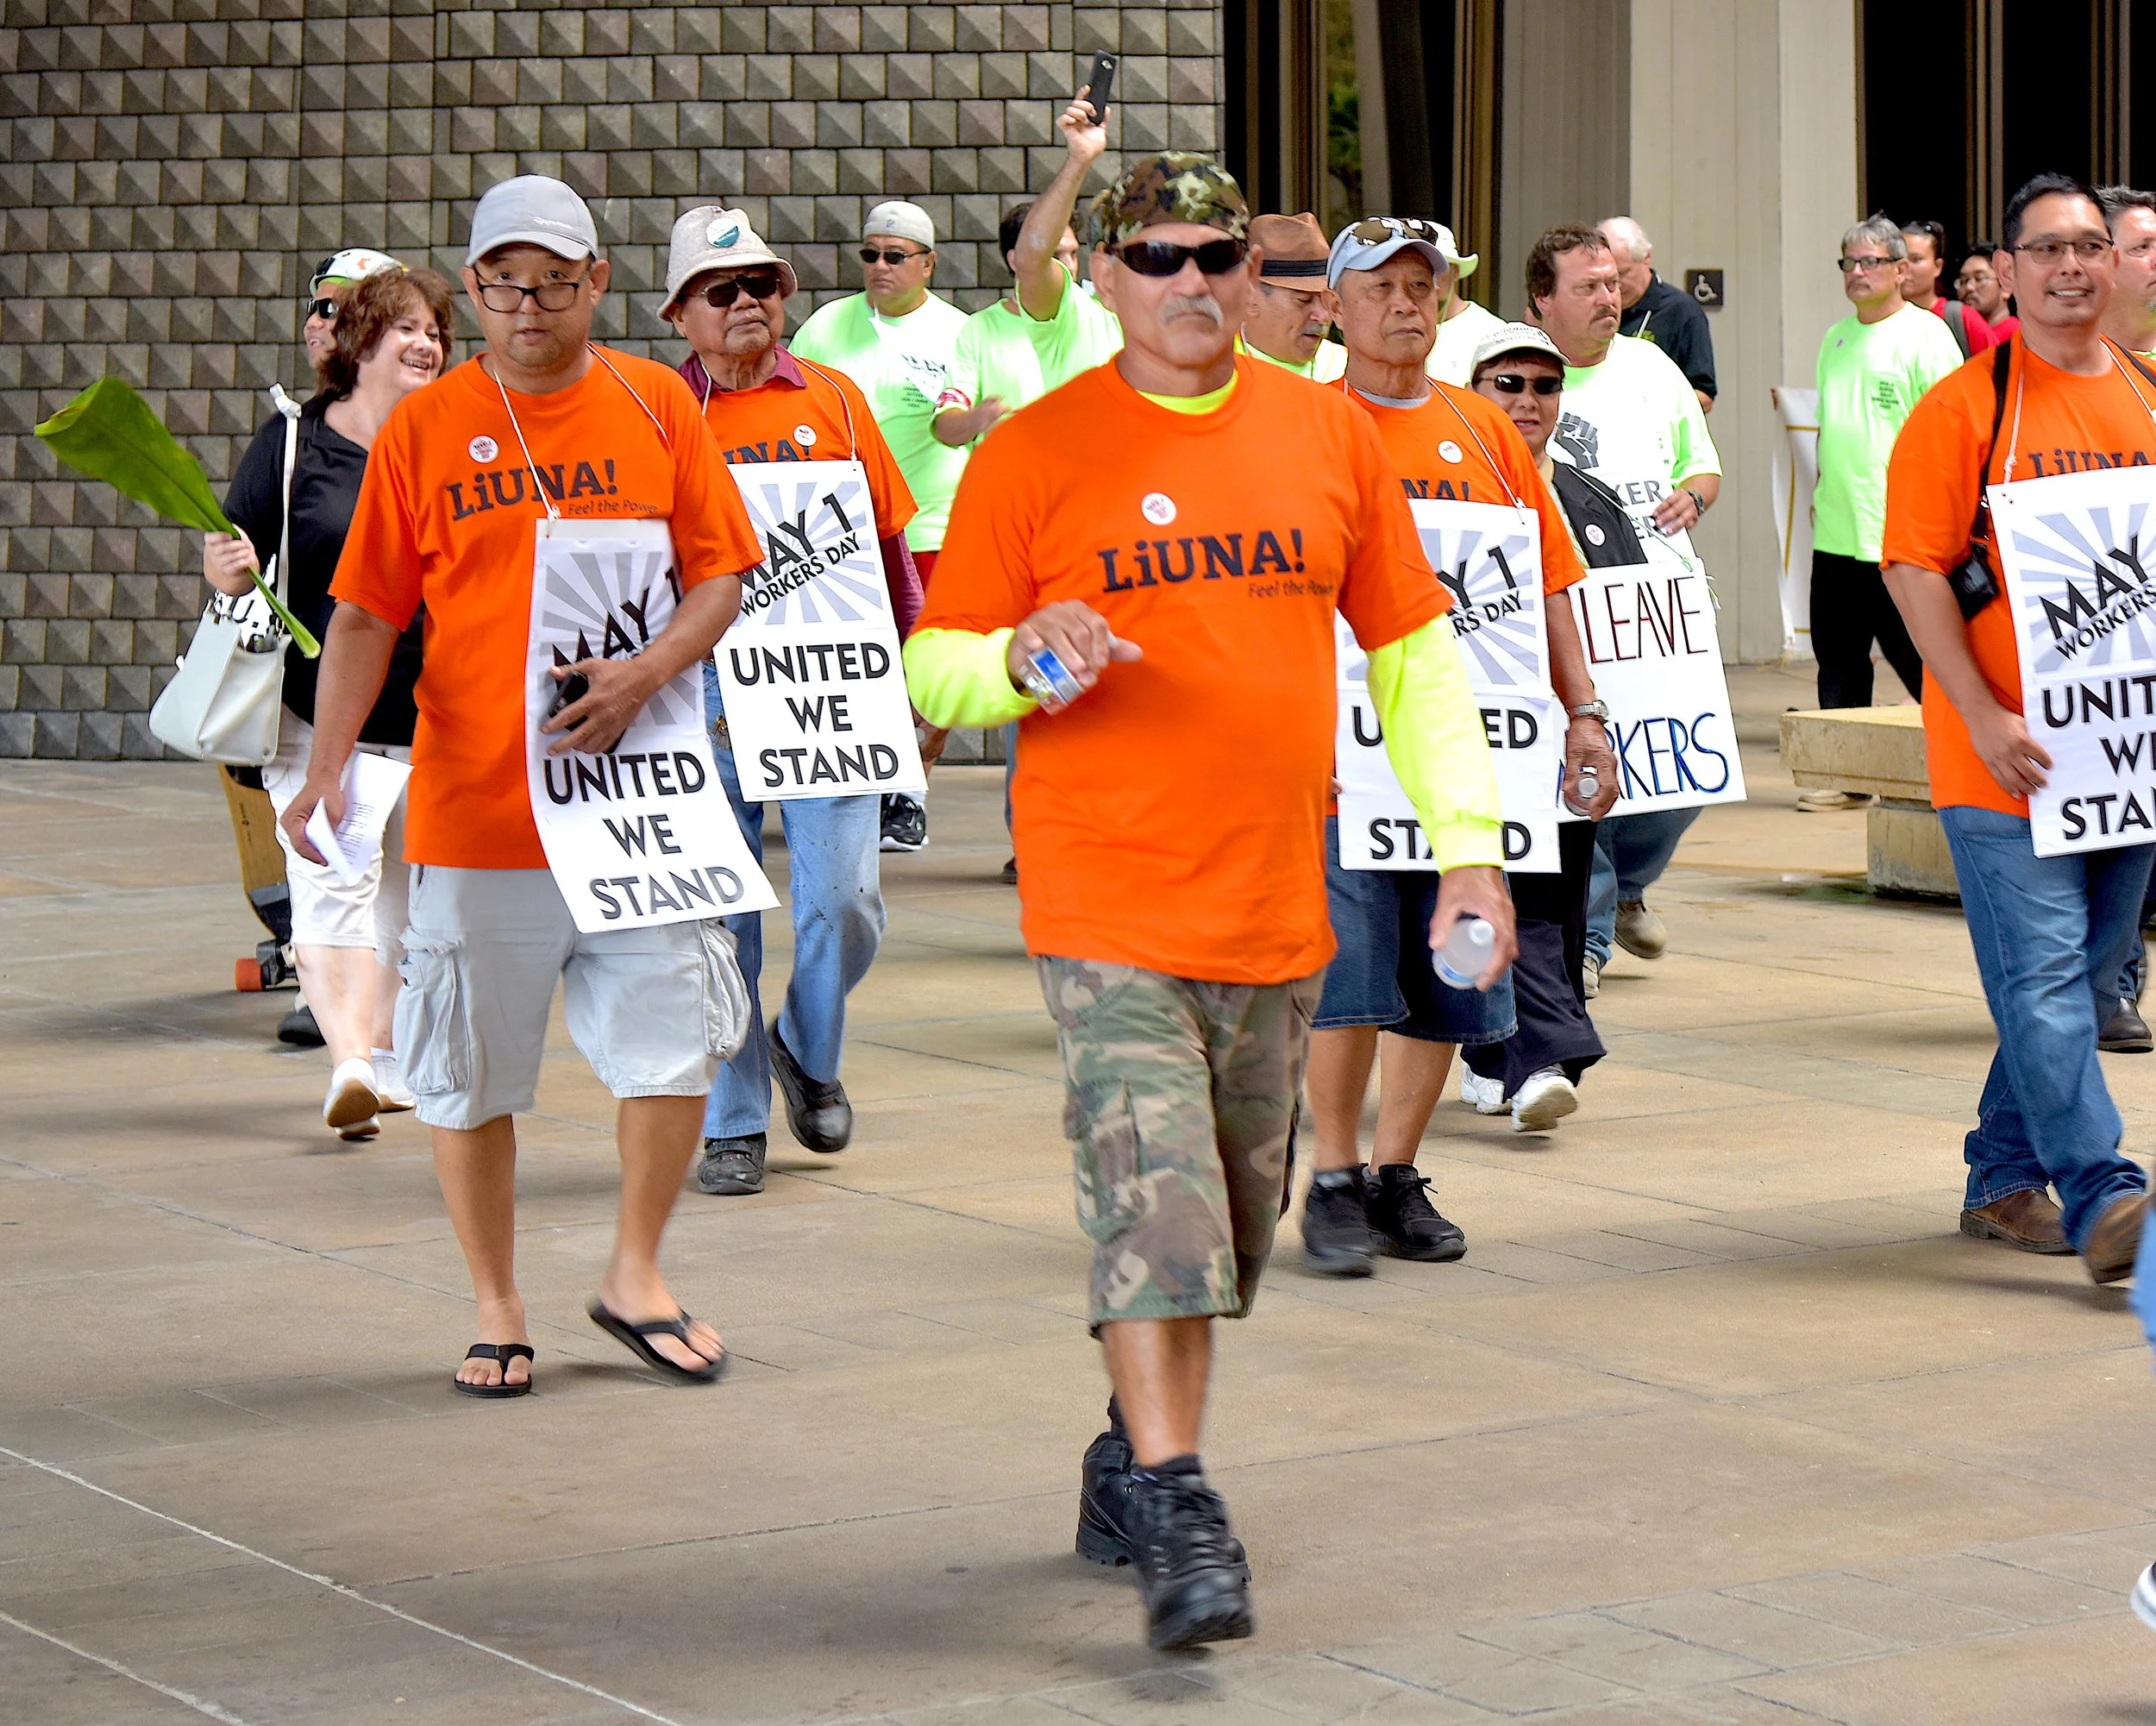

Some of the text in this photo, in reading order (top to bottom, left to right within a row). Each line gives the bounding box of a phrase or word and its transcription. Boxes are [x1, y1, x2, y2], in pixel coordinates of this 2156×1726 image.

[445, 459, 618, 521] LiUNA!
[568, 500, 594, 515] Feel
[598, 499, 619, 513] the
[822, 493, 852, 533] 1
[740, 532, 861, 618] WORKERS DAY
[1098, 528, 1305, 593] LiUNA!
[1486, 545, 1517, 590] 1
[1249, 580, 1280, 599] Feel
[1482, 589, 1523, 622] DAY
[2038, 534, 2149, 640] MAY
[1578, 575, 1708, 663] LEAVE
[730, 643, 891, 686] UNITED
[785, 694, 853, 734] WE
[544, 751, 705, 806] UNITED
[759, 744, 899, 788] STAND
[604, 813, 682, 859] WE
[589, 865, 744, 920] STAND
